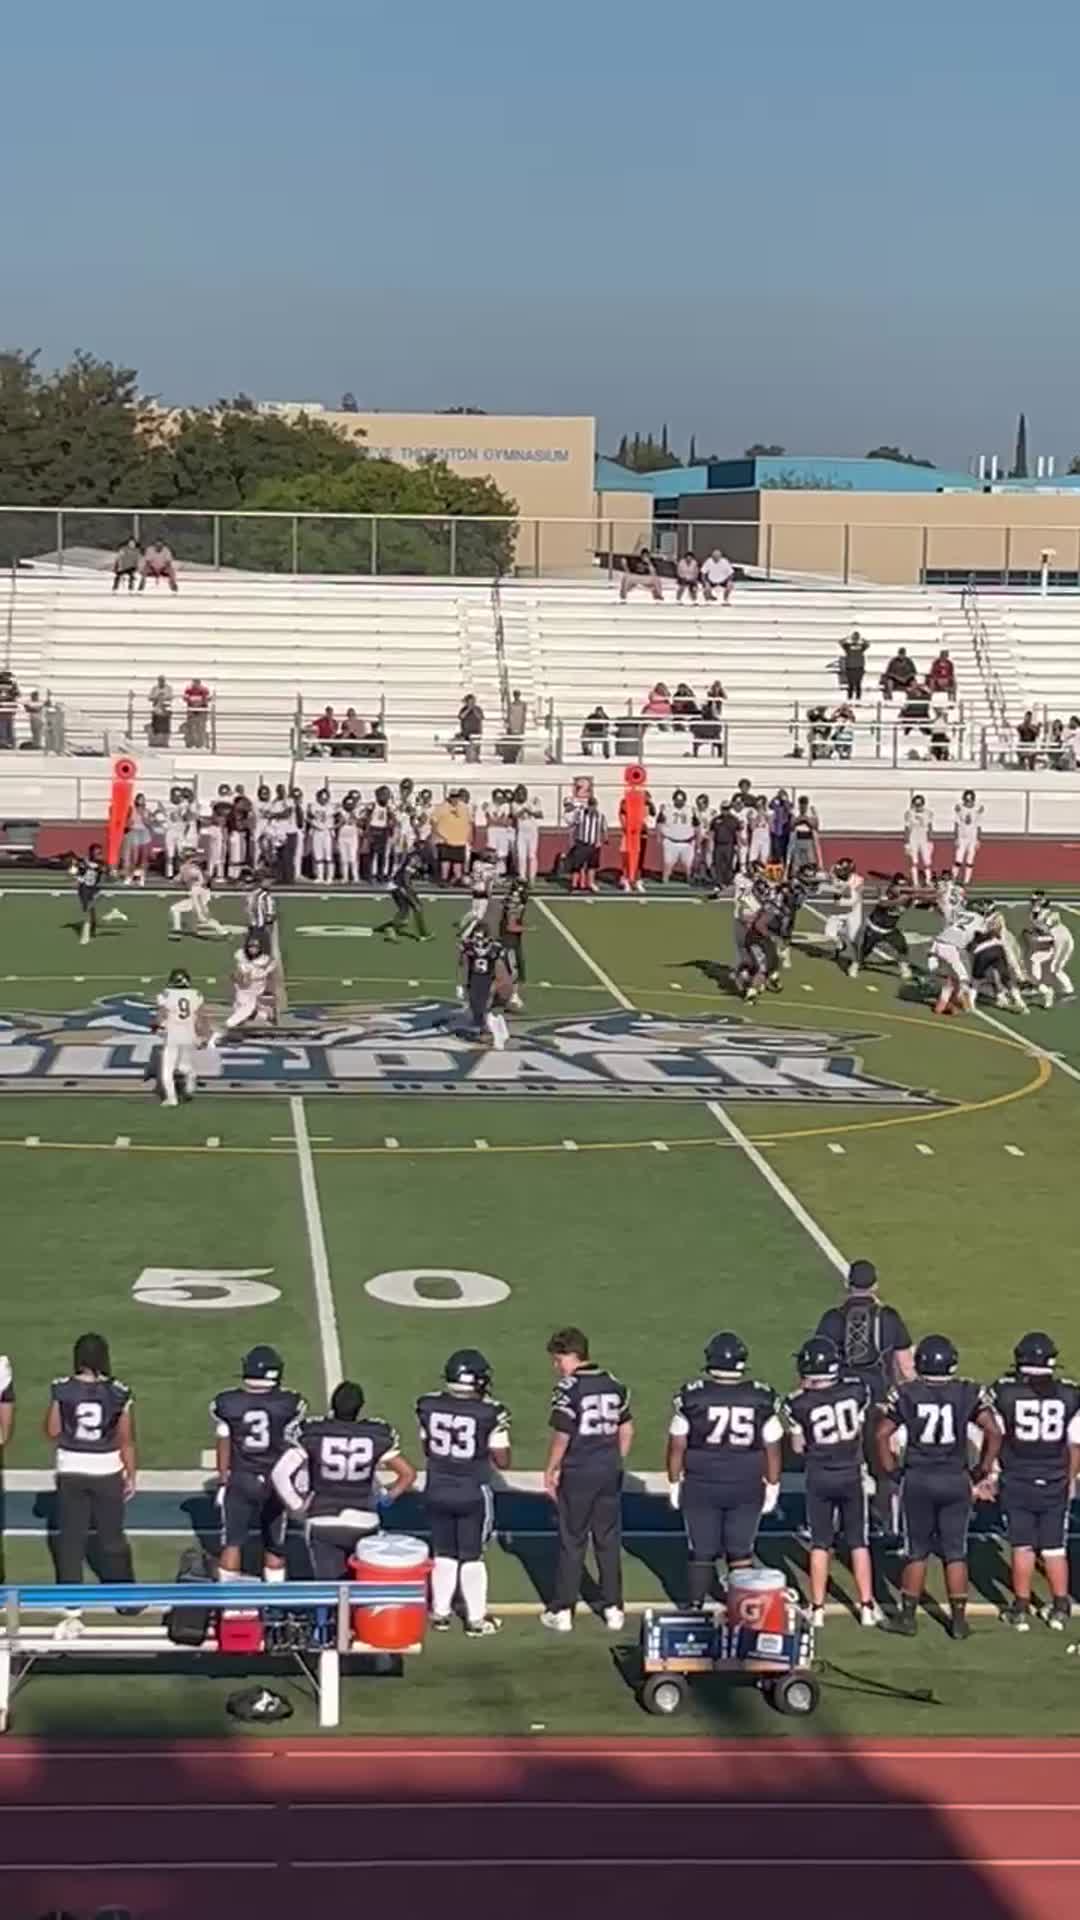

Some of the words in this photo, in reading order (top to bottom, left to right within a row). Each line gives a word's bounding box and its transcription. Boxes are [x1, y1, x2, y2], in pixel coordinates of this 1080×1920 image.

[483, 447, 569, 462] GYMNASIUM
[178, 998, 191, 1020] 9
[76, 1402, 102, 1441] 2
[243, 1410, 270, 1448] 3
[579, 1394, 620, 1436] 25
[706, 1406, 755, 1445] 75
[810, 1398, 858, 1444] 20
[917, 1404, 956, 1443] 71
[1014, 1400, 1066, 1442] 58
[429, 1412, 477, 1459] 53
[320, 1437, 374, 1481] 52
[740, 1598, 761, 1621] G
